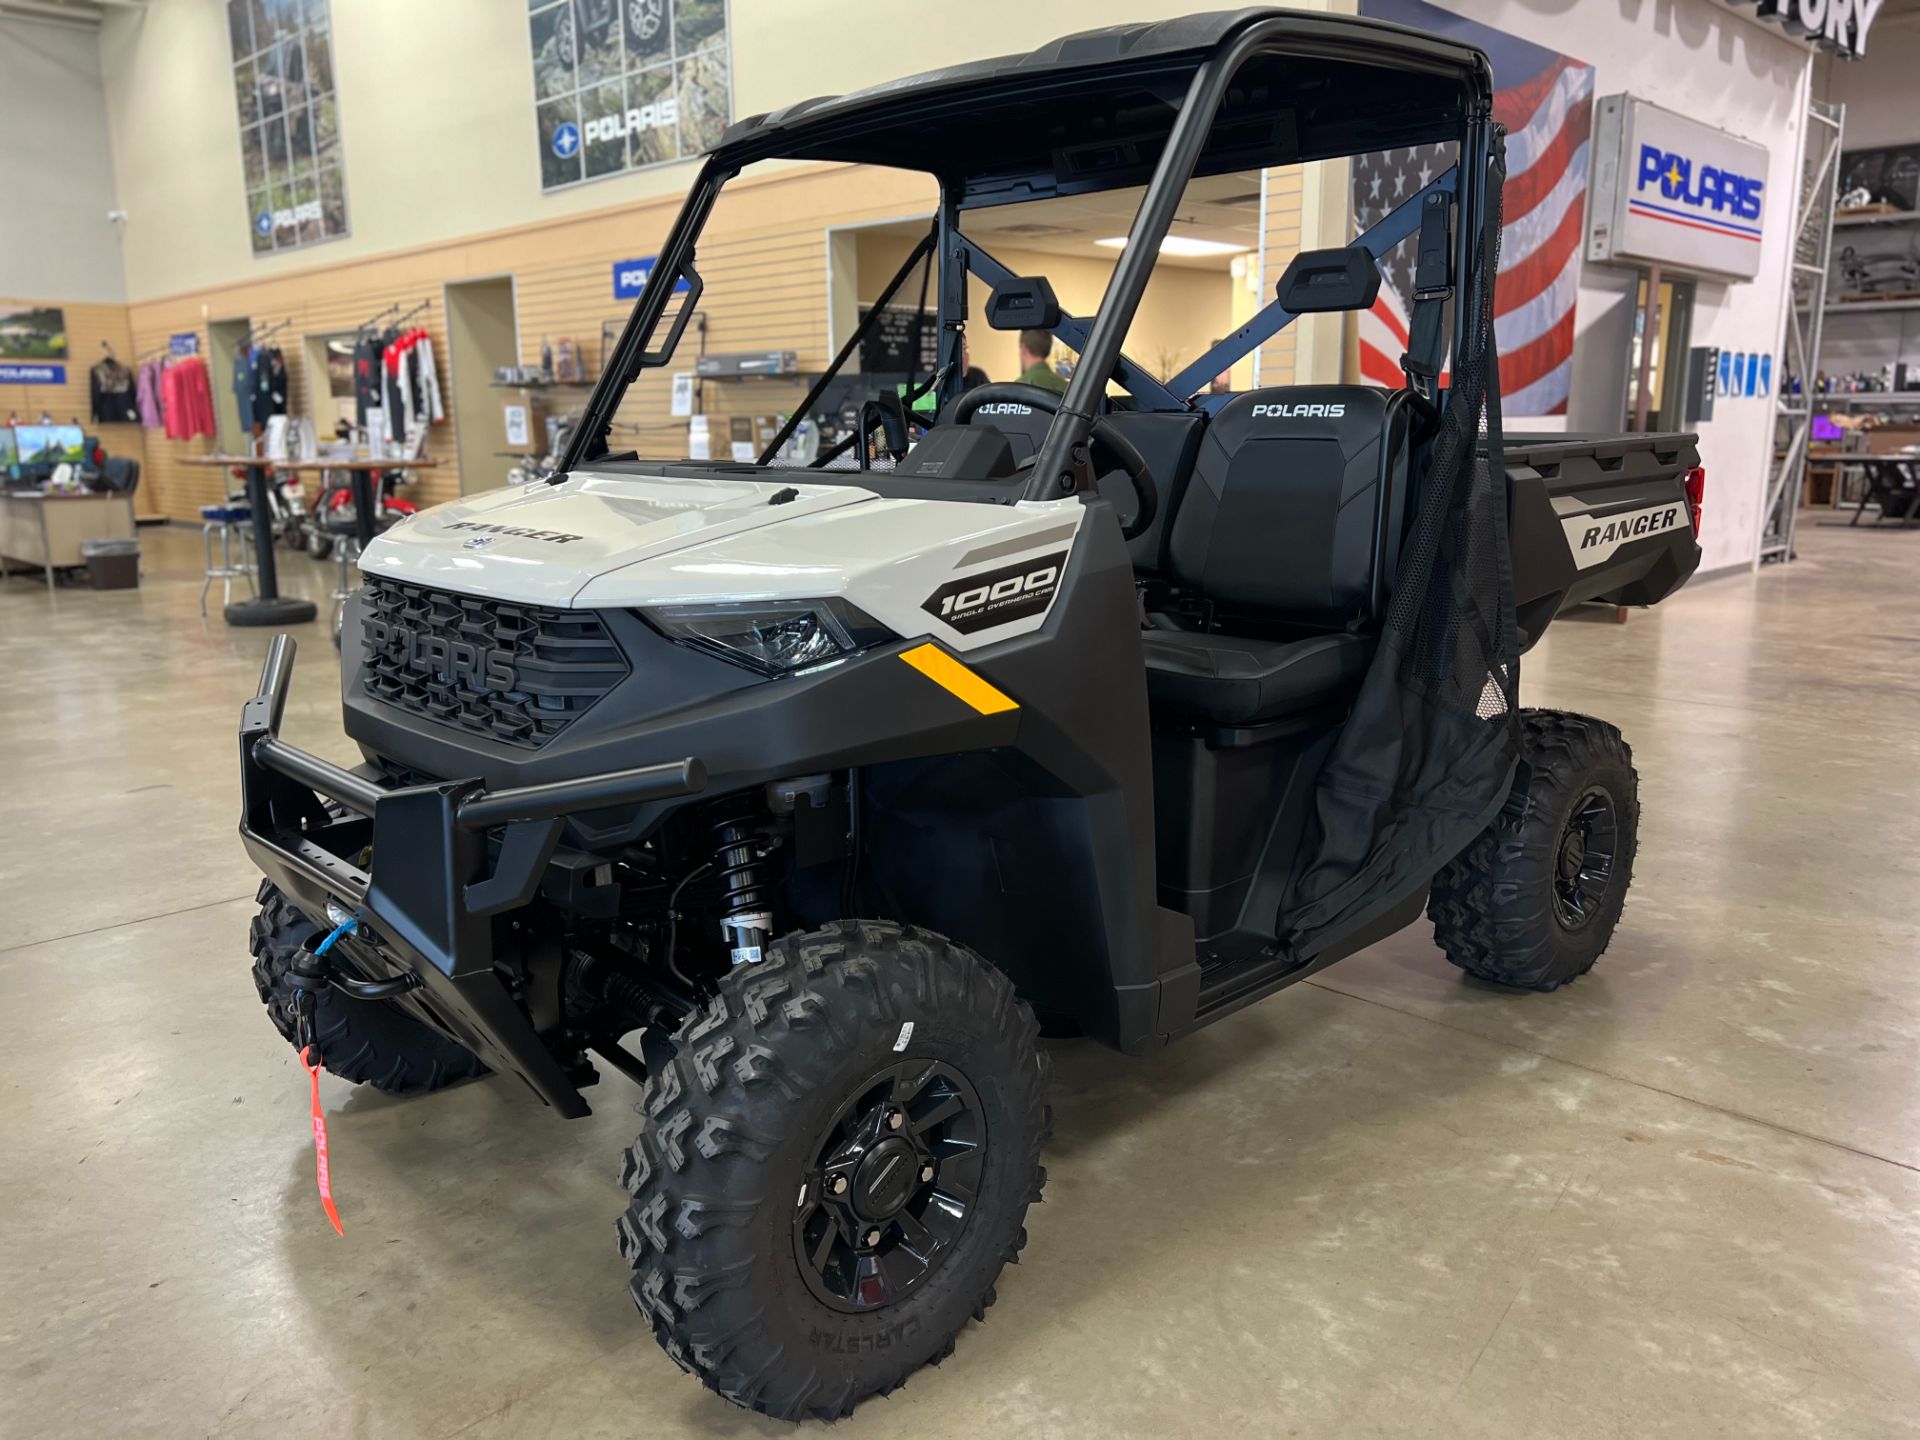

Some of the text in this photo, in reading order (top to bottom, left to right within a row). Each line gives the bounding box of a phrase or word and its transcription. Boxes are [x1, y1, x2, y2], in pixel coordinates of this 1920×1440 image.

[584, 100, 679, 146] POLARIS
[1637, 143, 1764, 221] POLARIS
[273, 200, 321, 228] POLARIS
[978, 403, 1032, 415] OLARIS
[1252, 404, 1346, 417] POLARIS
[442, 521, 585, 544] RANGER
[1580, 508, 1678, 550] RANGER
[940, 566, 1058, 616] 1000
[950, 586, 1055, 622] SINGLE OVERHEAD CAM
[362, 617, 518, 692] POLARIS
[313, 1116, 331, 1200] POLARIS
[808, 1314, 920, 1355] CARLSTAR
